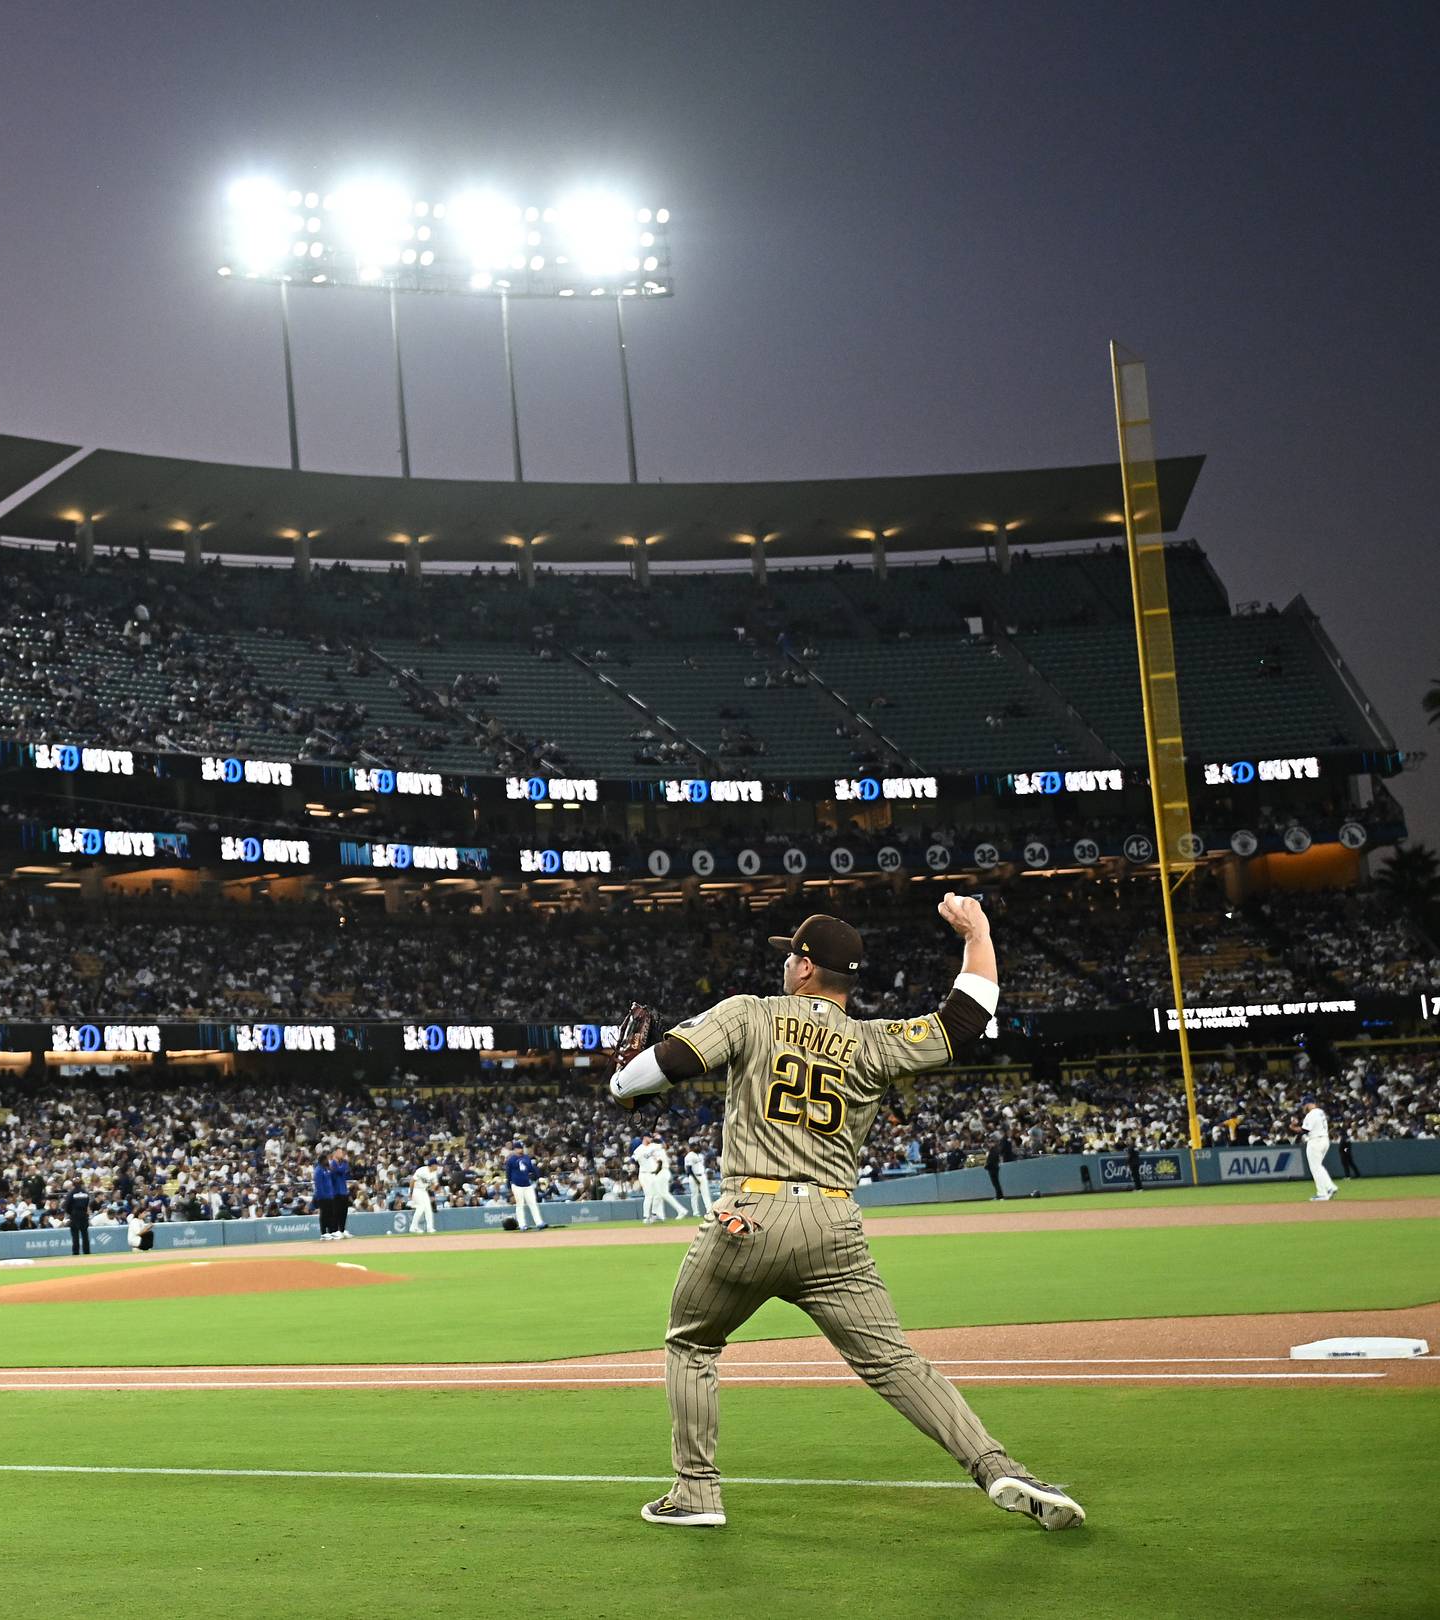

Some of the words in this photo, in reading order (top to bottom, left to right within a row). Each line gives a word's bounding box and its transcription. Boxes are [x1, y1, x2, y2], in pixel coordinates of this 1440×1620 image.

[976, 848, 997, 864] 32
[1026, 847, 1046, 862] 34
[1127, 840, 1148, 857] 42
[656, 855, 663, 871] 1
[698, 855, 709, 871] 2
[743, 854, 754, 870] 4
[787, 853, 802, 869] 14
[834, 853, 850, 868] 19
[879, 851, 899, 868] 20
[928, 850, 948, 865] 24
[1196, 1006, 1229, 1019] WANT
[1229, 1006, 1245, 1017] TO
[1245, 1005, 1263, 1016] BE
[1282, 1002, 1307, 1015] BUT
[1307, 1002, 1319, 1013] IF
[774, 1015, 858, 1065] FRANCE
[765, 1050, 846, 1136] 25
[1227, 1156, 1271, 1176] ANA
[26, 1240, 47, 1249] BANK
[48, 1239, 60, 1247] OF
